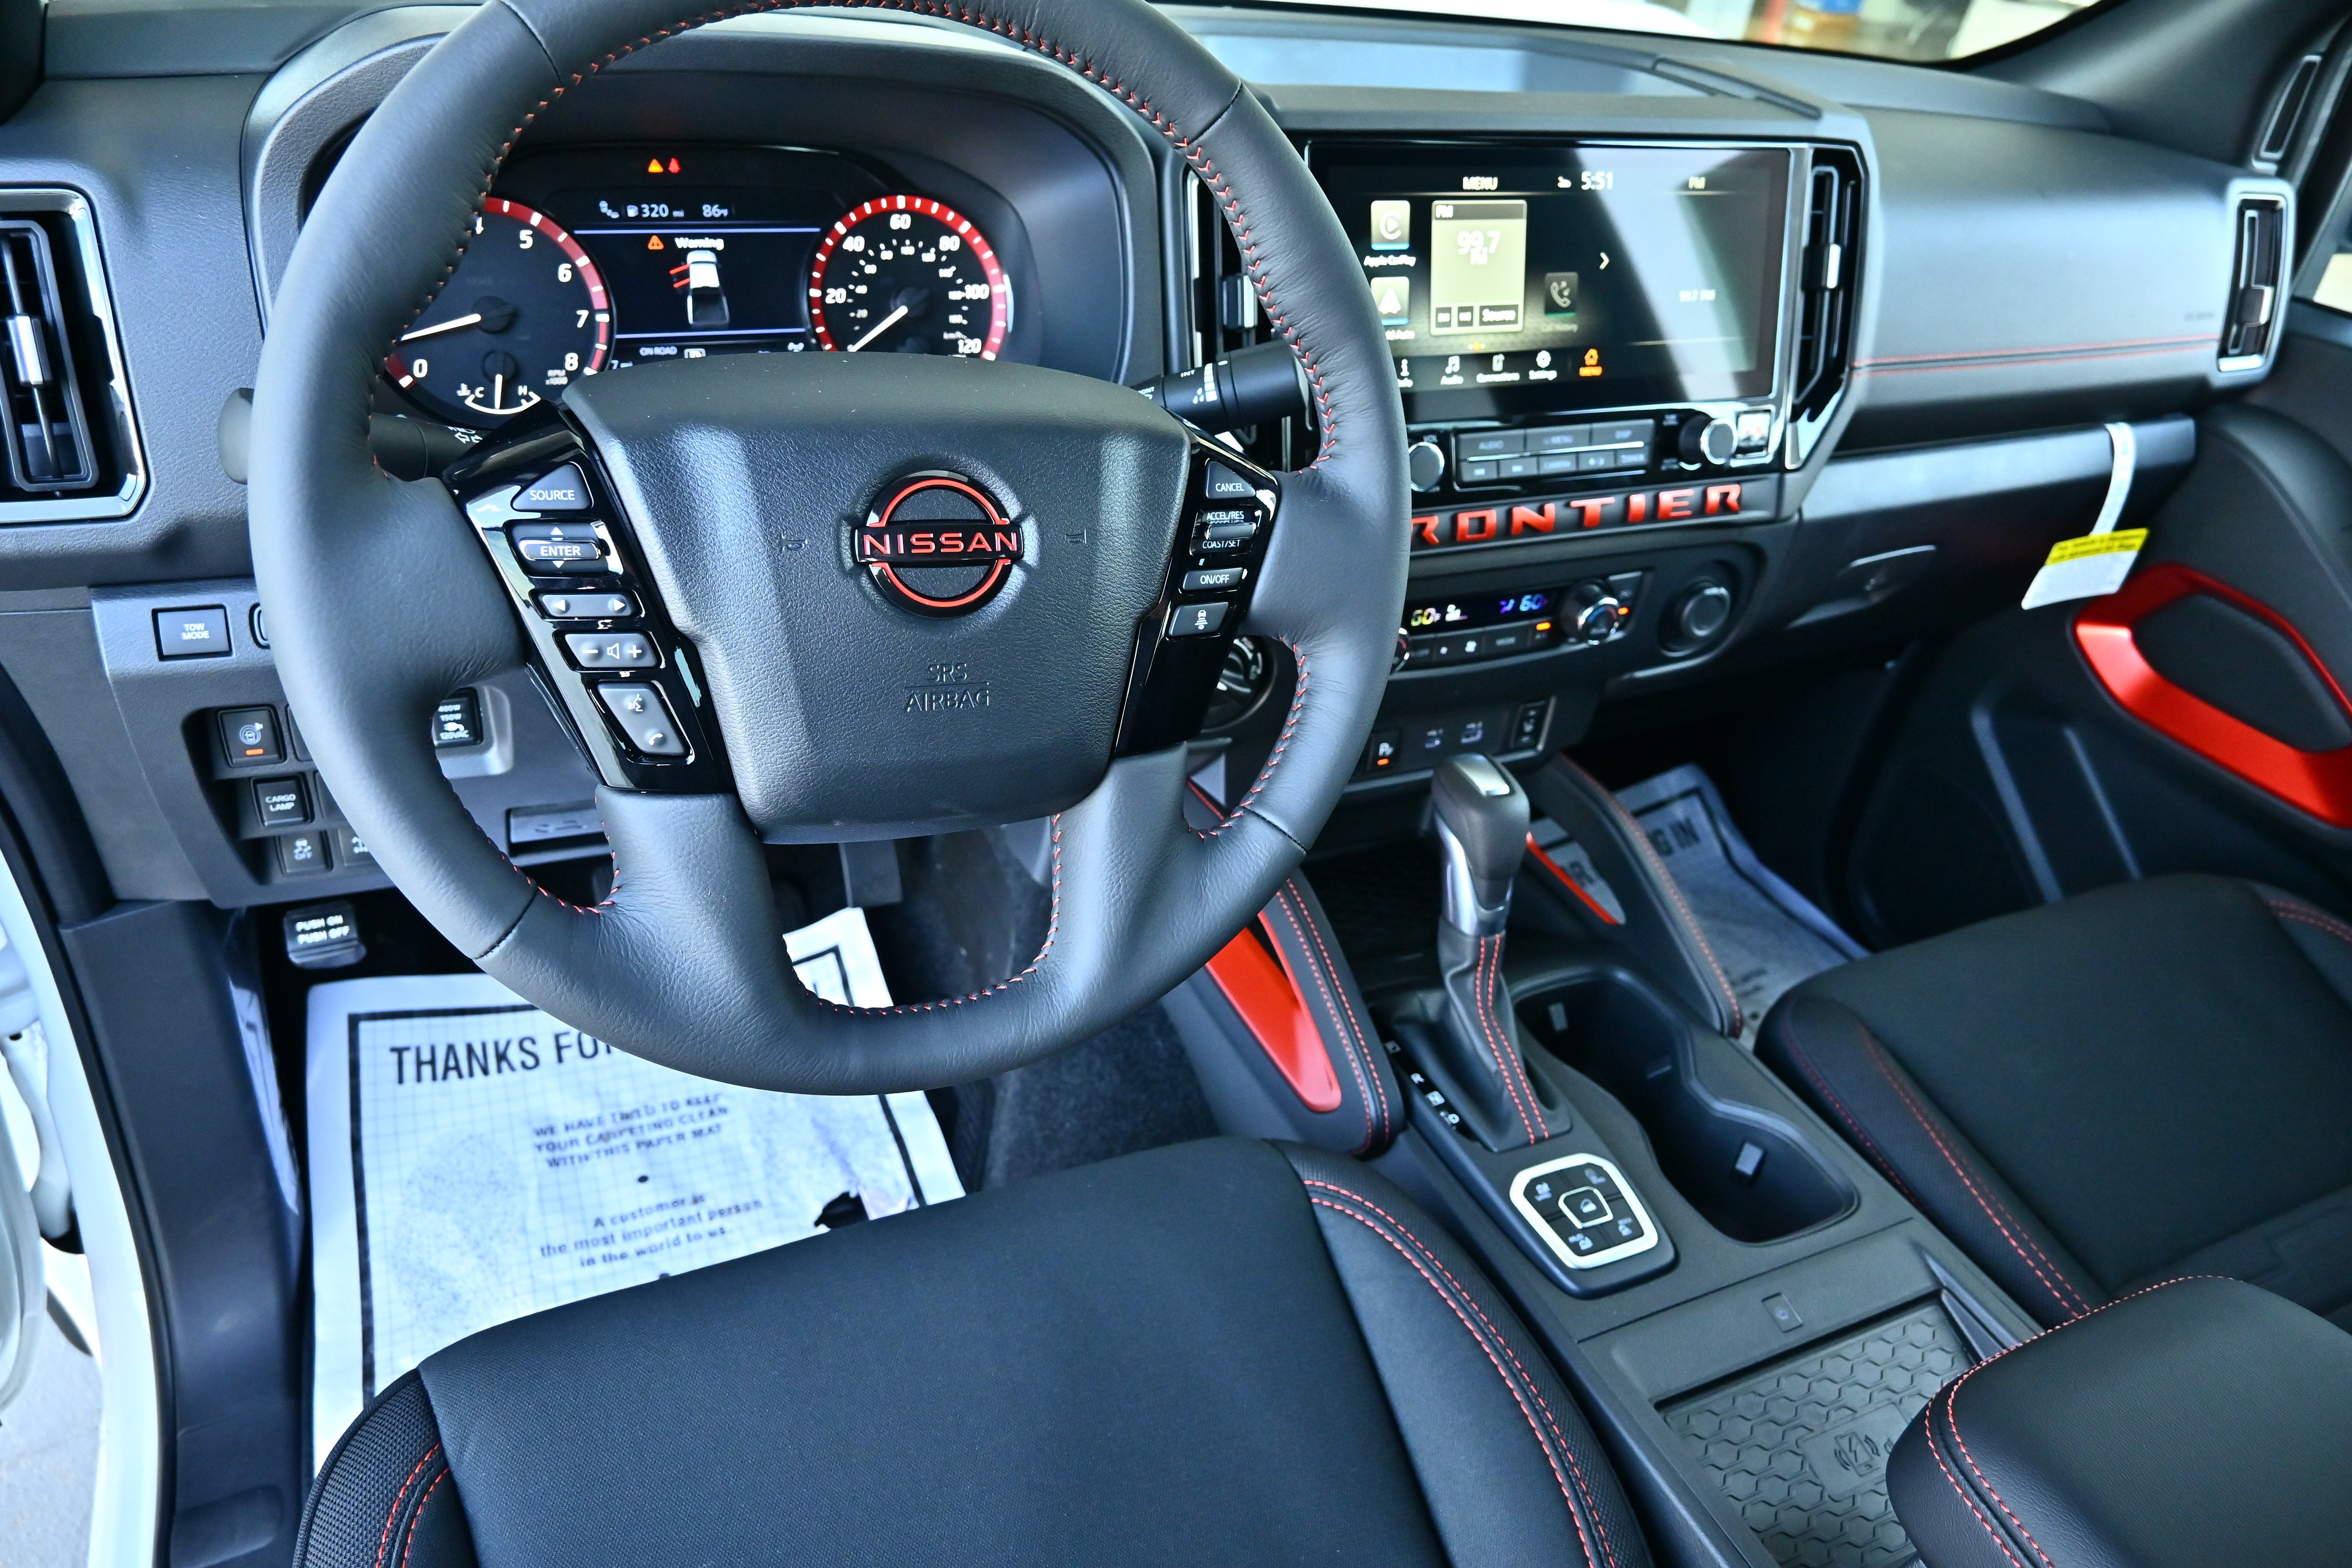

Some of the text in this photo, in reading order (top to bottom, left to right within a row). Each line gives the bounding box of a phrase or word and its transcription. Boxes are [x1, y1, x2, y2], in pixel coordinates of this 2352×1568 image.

[1463, 177, 1498, 190] MENU
[1581, 172, 1613, 190] 5:51
[1689, 177, 1706, 190] FM
[641, 204, 669, 218] 320
[890, 214, 911, 229] 60
[520, 230, 533, 249] 5
[675, 237, 724, 250] Warning
[843, 236, 865, 251] 40
[939, 236, 960, 251] 80
[1457, 230, 1501, 254] 99.7
[558, 264, 572, 282] 6
[825, 288, 846, 303] 20
[964, 284, 989, 299] 100
[577, 310, 588, 328] 7
[640, 346, 678, 356] ON ROAD
[958, 338, 981, 353] 120
[414, 359, 427, 377] 0
[565, 354, 578, 371] 8
[475, 387, 485, 398] C
[518, 386, 528, 395] H
[1138, 387, 1154, 395] ONT
[1215, 482, 1244, 493] CANCEL
[530, 490, 575, 501] SOURCE
[1206, 511, 1244, 521] ACCEL/RES
[1411, 485, 1740, 545] RONTIER
[863, 532, 1017, 555] NISSAN
[1202, 539, 1241, 549] COAST/SET
[540, 546, 581, 557] ENTER
[1200, 574, 1230, 585] ON/OFF
[182, 630, 210, 640] MODE
[184, 623, 205, 632] TOW
[928, 663, 967, 683] SRS
[906, 682, 990, 712] AIRBAG
[440, 730, 469, 740] 120VAC
[265, 794, 296, 803] CARGO
[270, 802, 294, 812] LAMP
[296, 914, 343, 932] PUSH ON
[297, 925, 350, 945] PUSH OFF
[390, 1036, 540, 1084] THANKS
[535, 1138, 580, 1153] YOUR
[679, 1107, 728, 1124] CLEAN
[535, 1126, 555, 1136] WE
[546, 1154, 589, 1168] WITH
[593, 1217, 605, 1228] A
[610, 1198, 685, 1226] customer
[540, 1199, 762, 1258] the most important person
[580, 1257, 596, 1267] in
[602, 1252, 628, 1264] the
[635, 1236, 681, 1257] world
[687, 1232, 702, 1243] to
